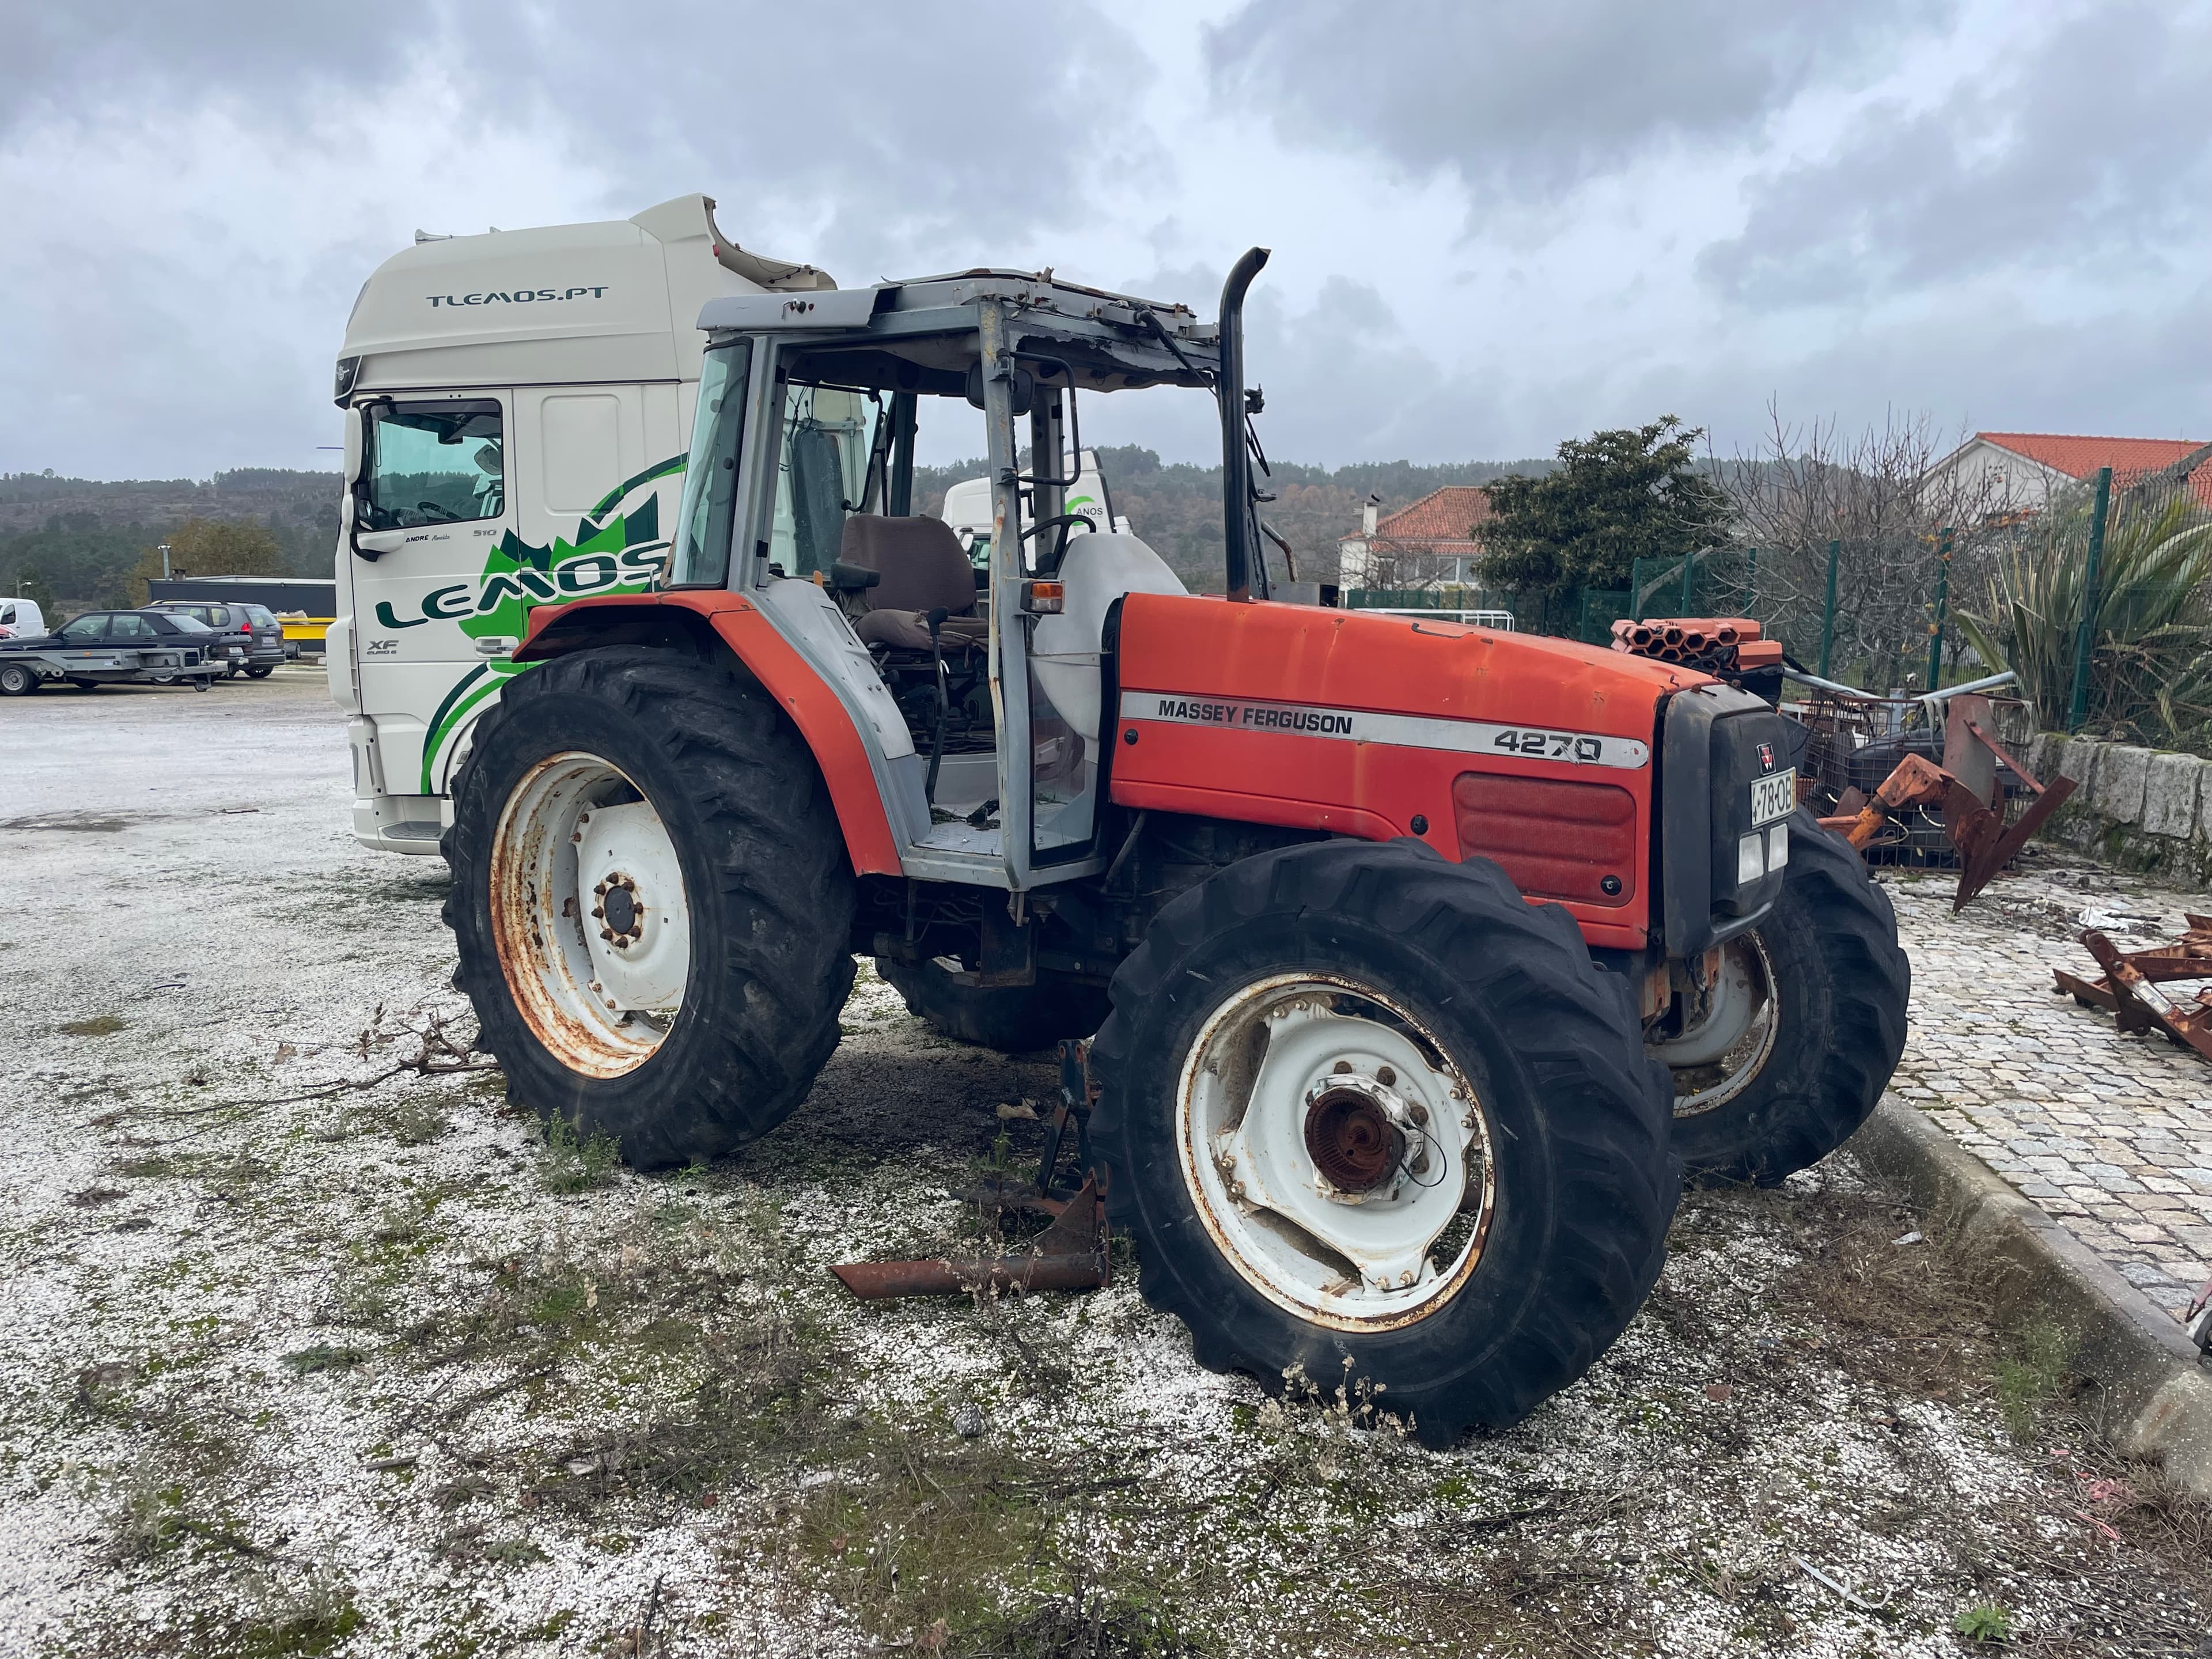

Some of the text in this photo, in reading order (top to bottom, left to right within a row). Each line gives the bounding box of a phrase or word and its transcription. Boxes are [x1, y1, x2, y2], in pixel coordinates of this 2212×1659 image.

[426, 286, 609, 307] TLEMOS.PT
[375, 541, 671, 628] LEMOS
[368, 639, 399, 650] XF
[1158, 699, 1352, 734] MASSEY FERGUSON
[1494, 730, 1602, 761] 4270
